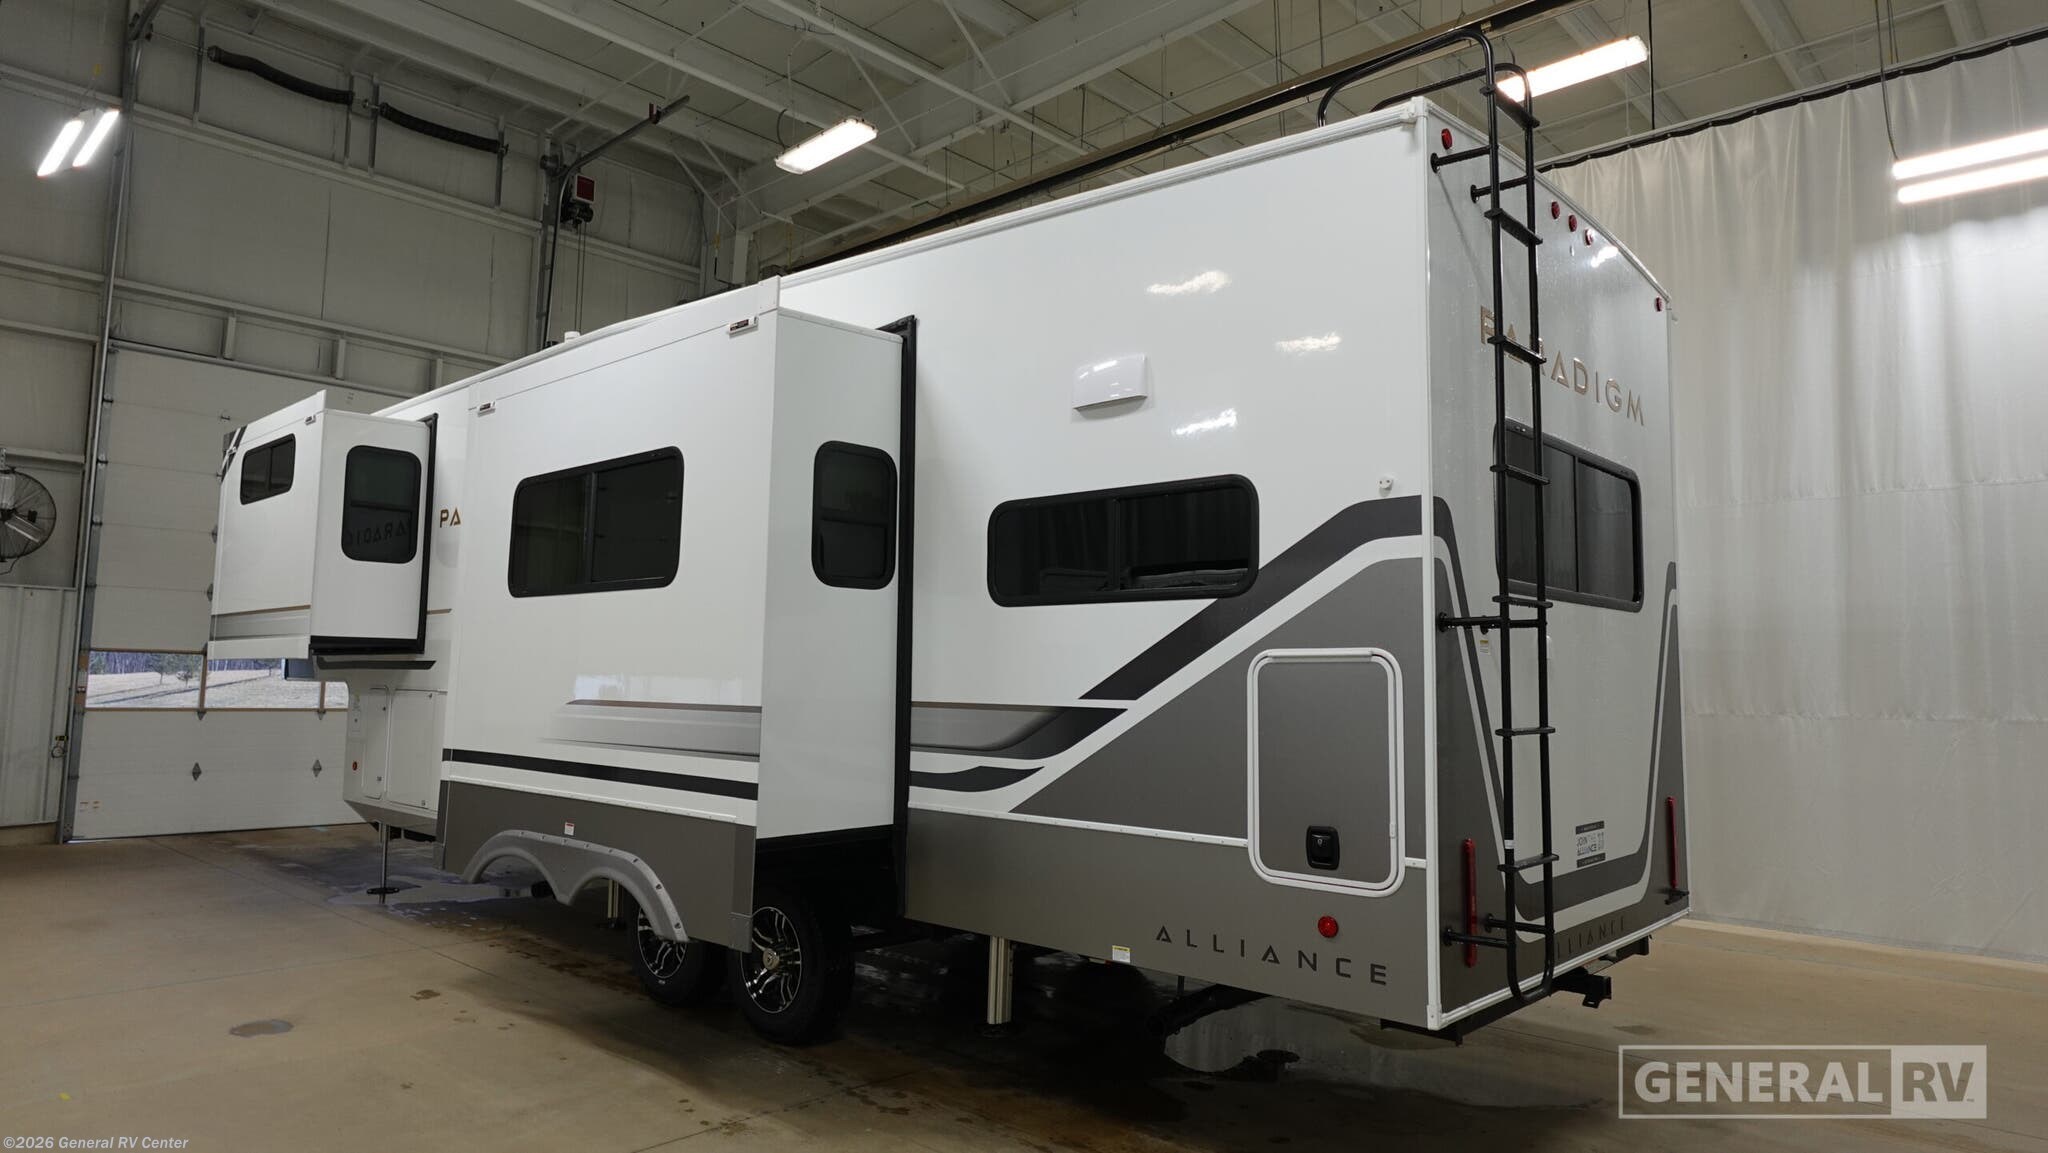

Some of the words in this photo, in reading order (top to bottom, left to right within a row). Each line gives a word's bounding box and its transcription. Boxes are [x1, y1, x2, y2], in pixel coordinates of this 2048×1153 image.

[1480, 305, 1644, 426] PAADIGM
[439, 508, 461, 528] PA
[1156, 925, 1386, 986] ALLIANCE
[1557, 916, 1624, 960] LLIANCE
